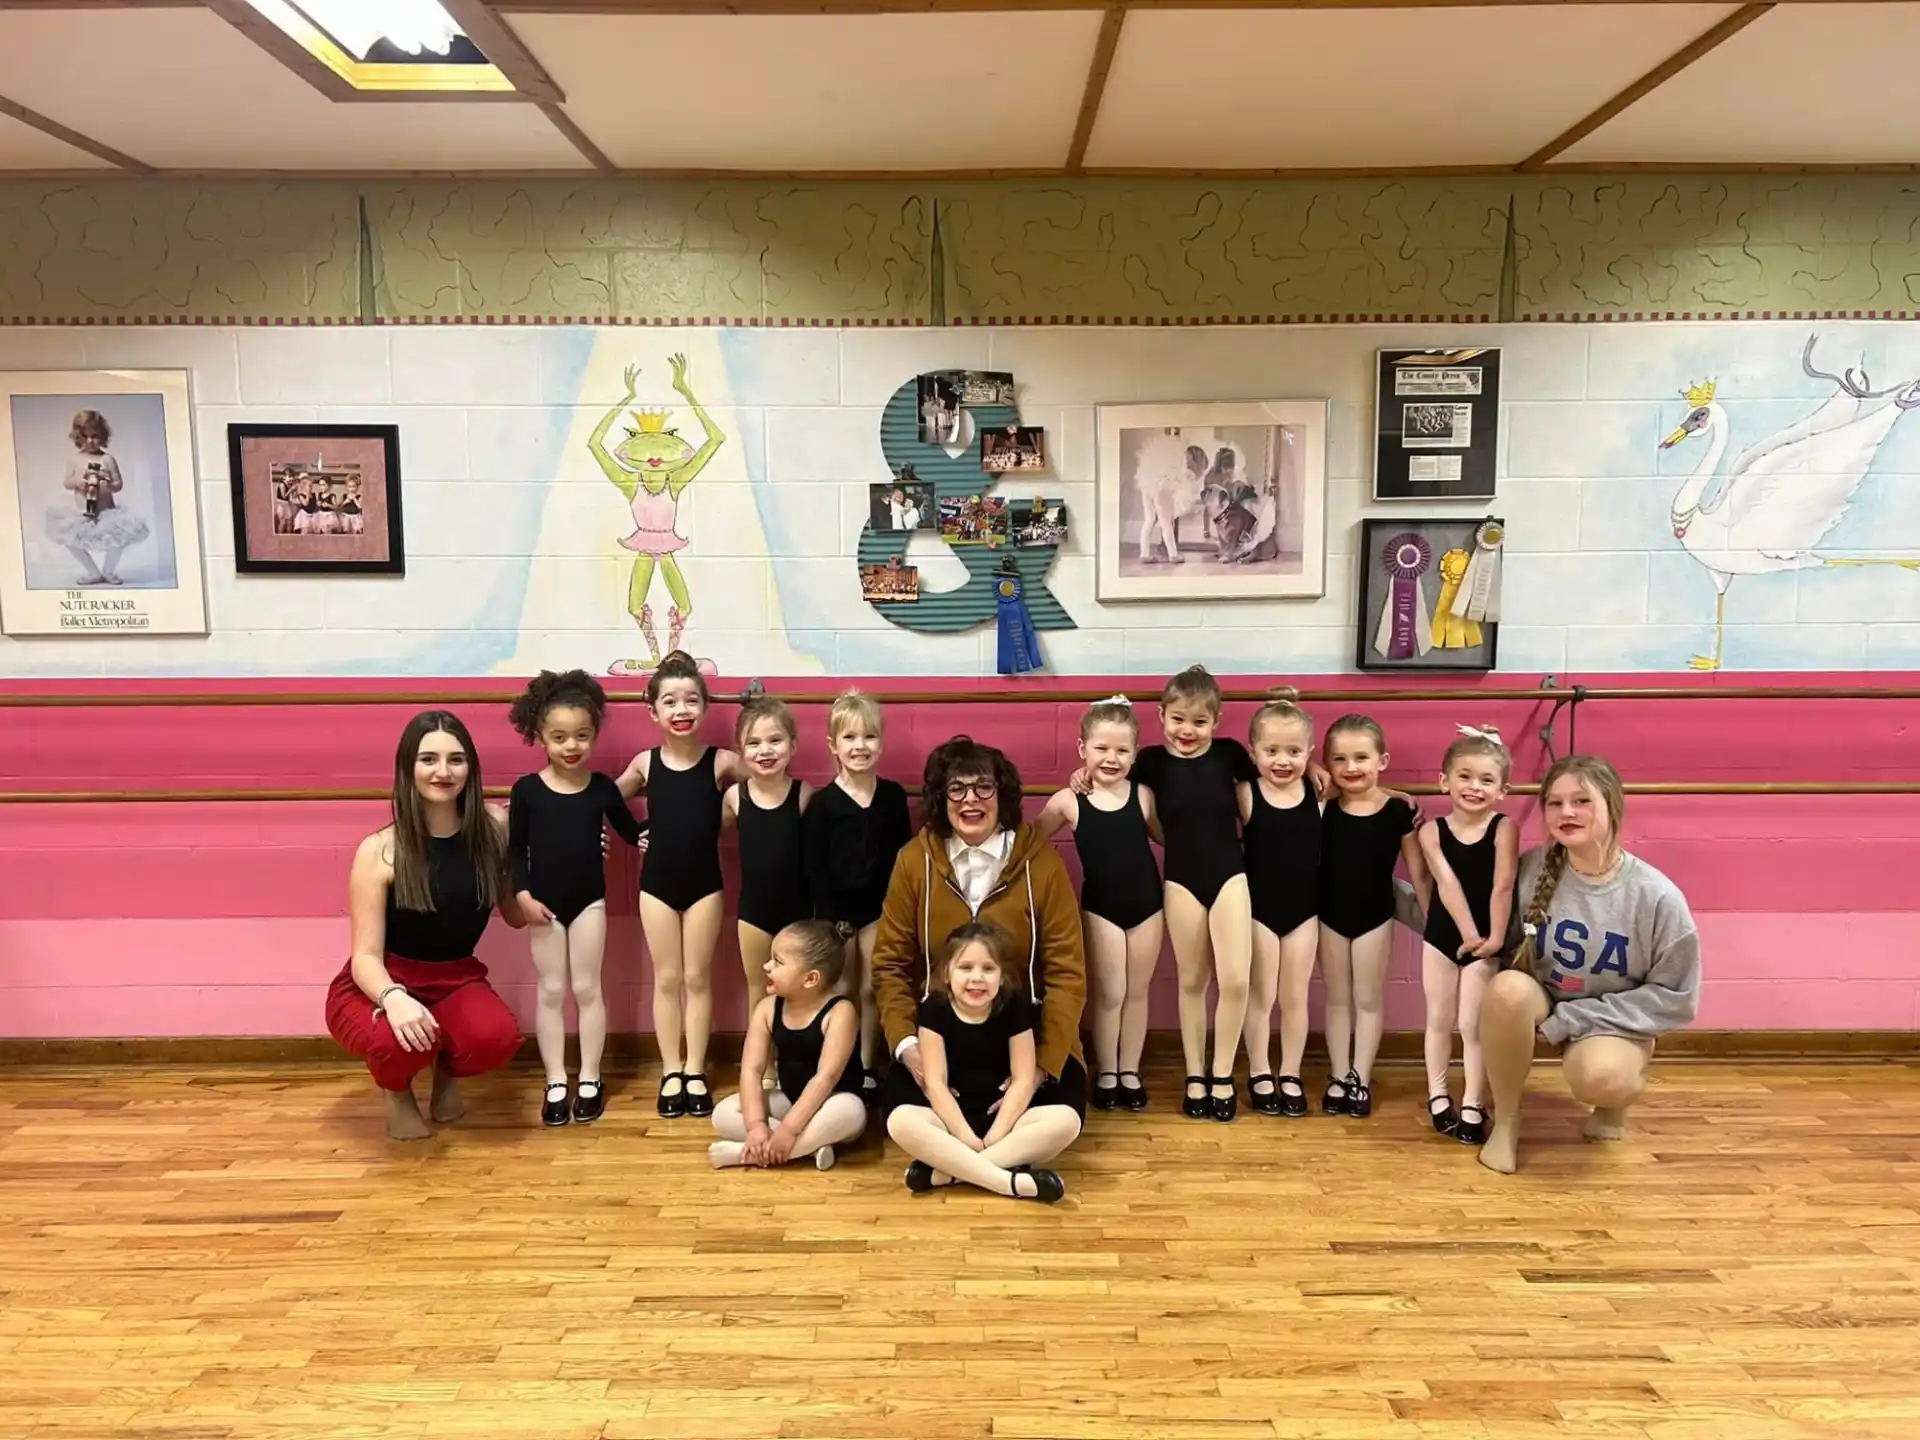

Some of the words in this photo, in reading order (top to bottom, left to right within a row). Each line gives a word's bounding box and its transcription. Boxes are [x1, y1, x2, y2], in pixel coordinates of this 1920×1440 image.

[67, 591, 84, 599] THE
[60, 600, 136, 611] NUTCRACKER
[60, 615, 87, 626] Ballet
[88, 615, 150, 629] Metropolitan
